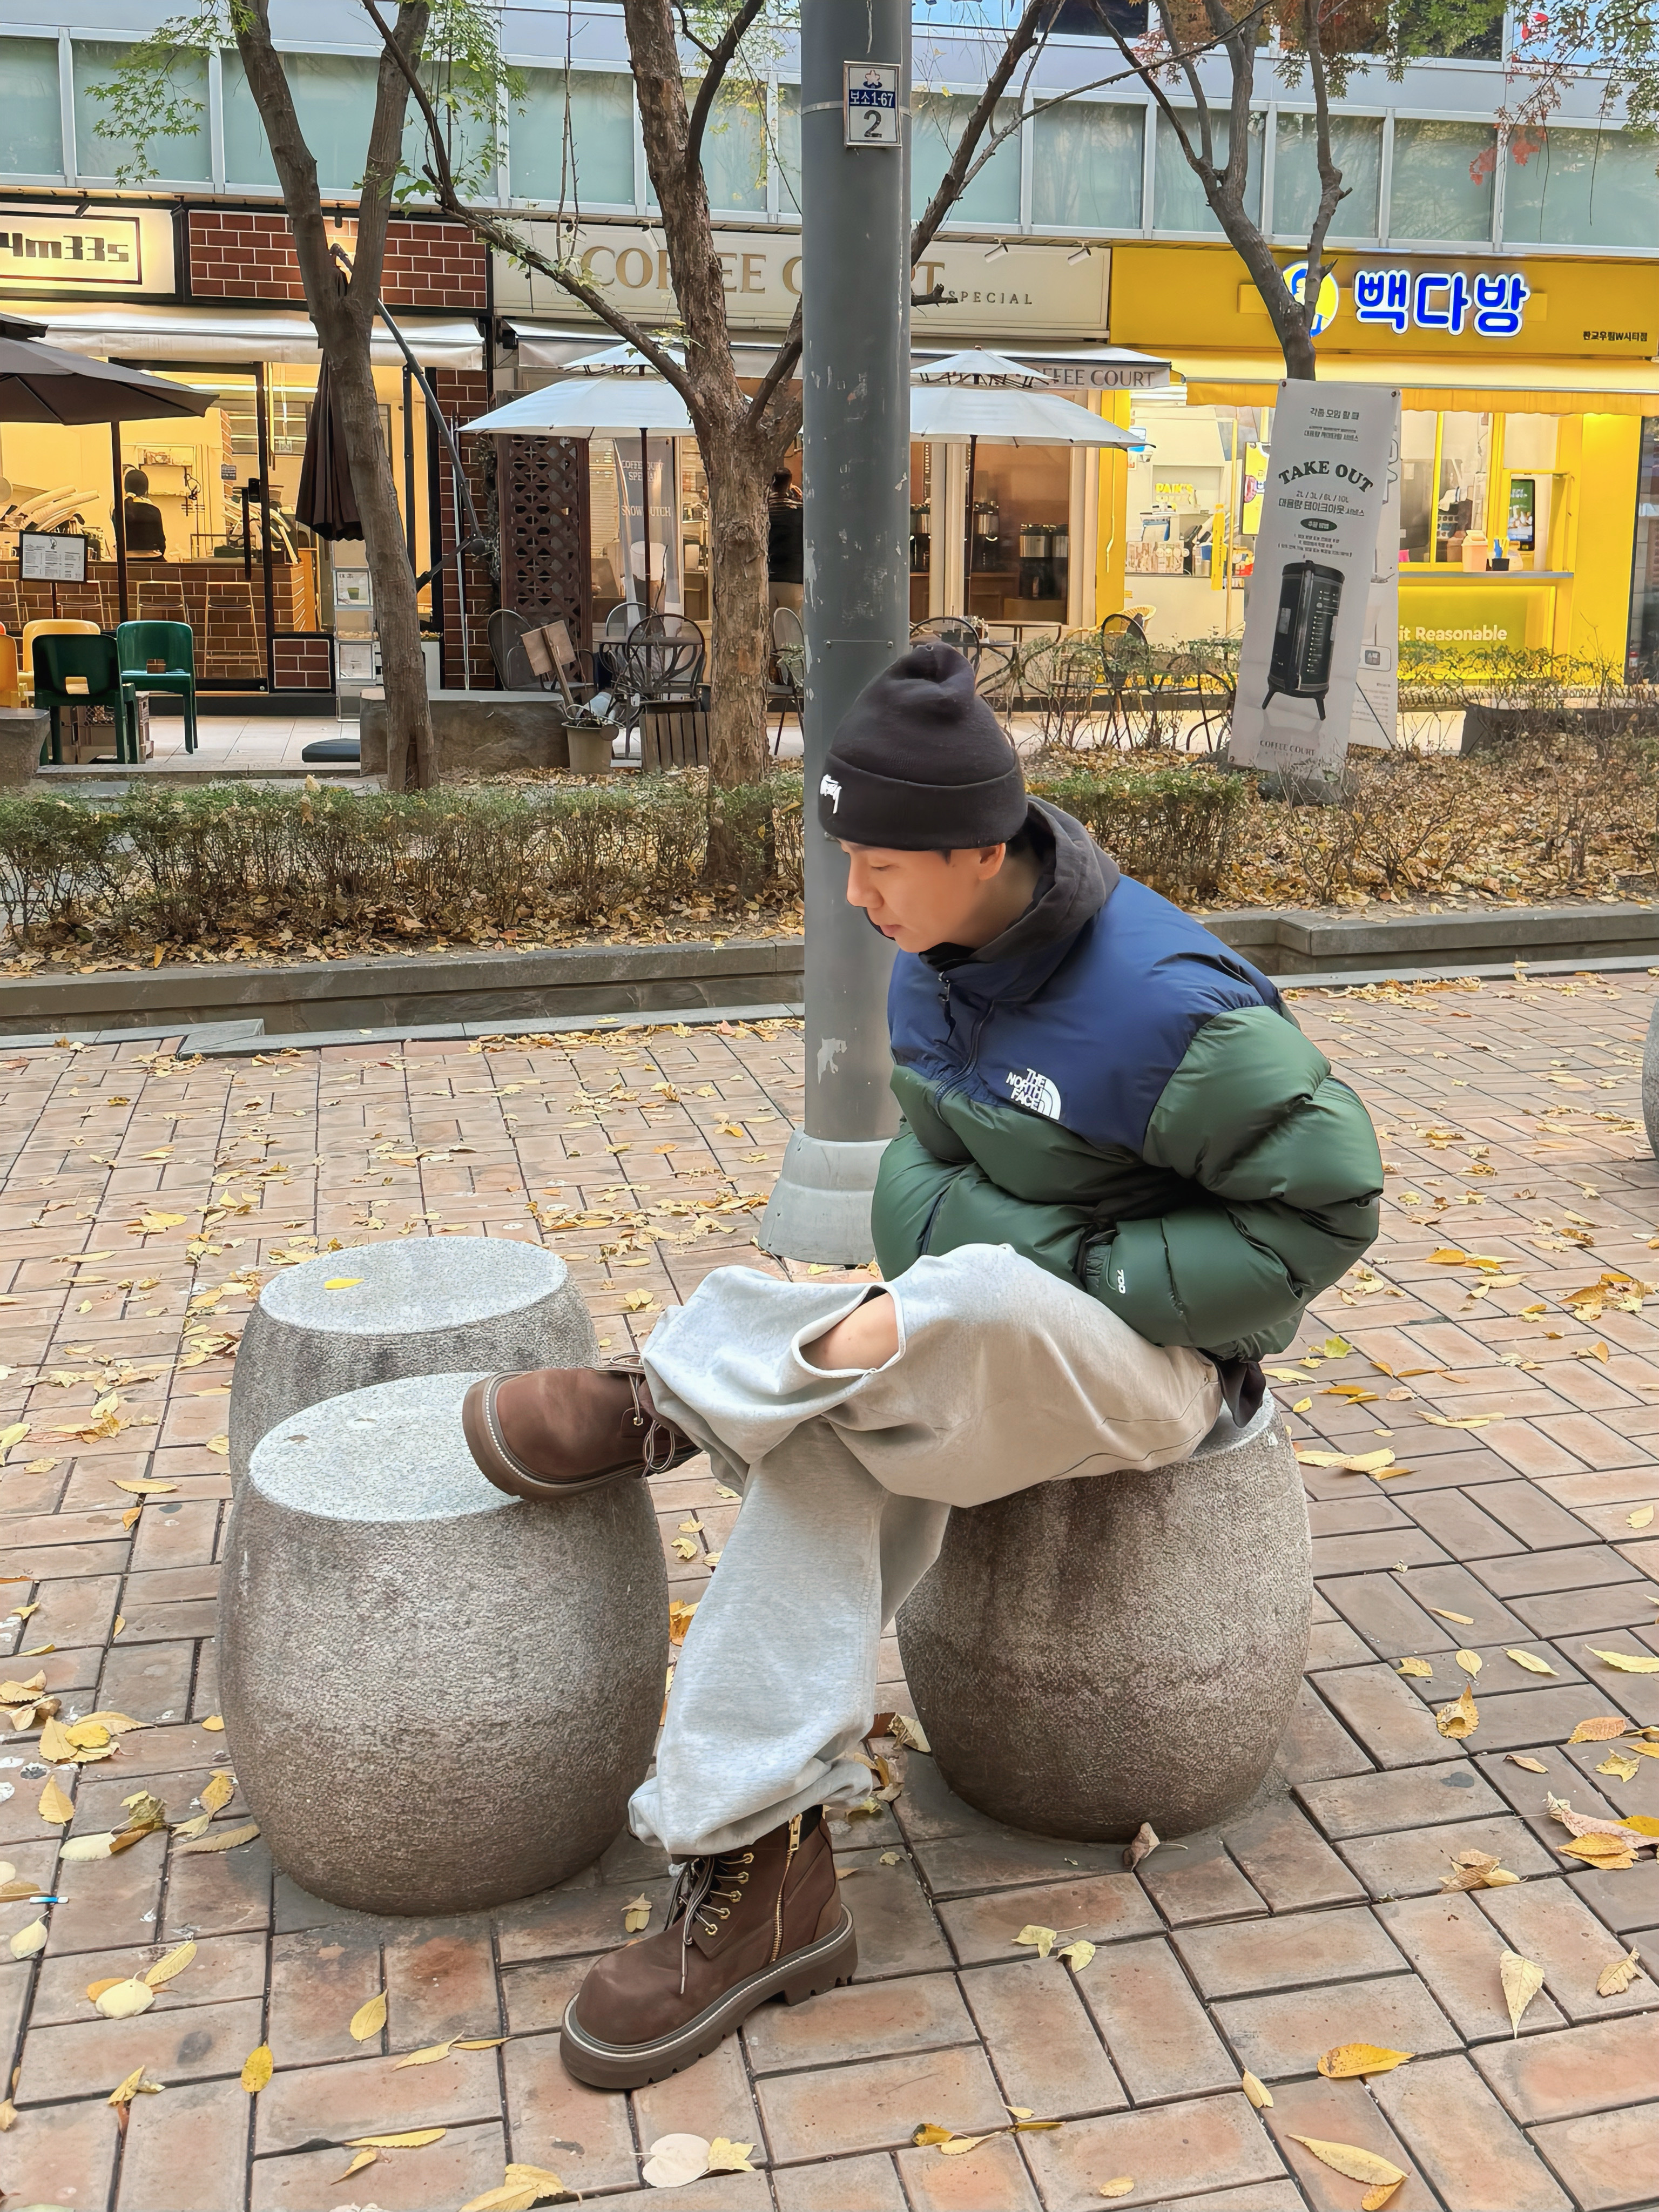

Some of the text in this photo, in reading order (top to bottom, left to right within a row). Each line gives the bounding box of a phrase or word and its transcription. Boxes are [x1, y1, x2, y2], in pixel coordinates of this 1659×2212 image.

[864, 110, 882, 138] 2
[948, 290, 1033, 305] SPECIAL
[1355, 270, 1530, 336] 빽다방
[1090, 369, 1155, 386] COURT
[1326, 409, 1341, 419] 모임
[1278, 461, 1373, 493] TAKE OUT
[1415, 624, 1507, 642] Reasonable
[1006, 1072, 1043, 1100] NORTH
[1027, 1068, 1046, 1088] THE
[1010, 1087, 1040, 1111] FACE
